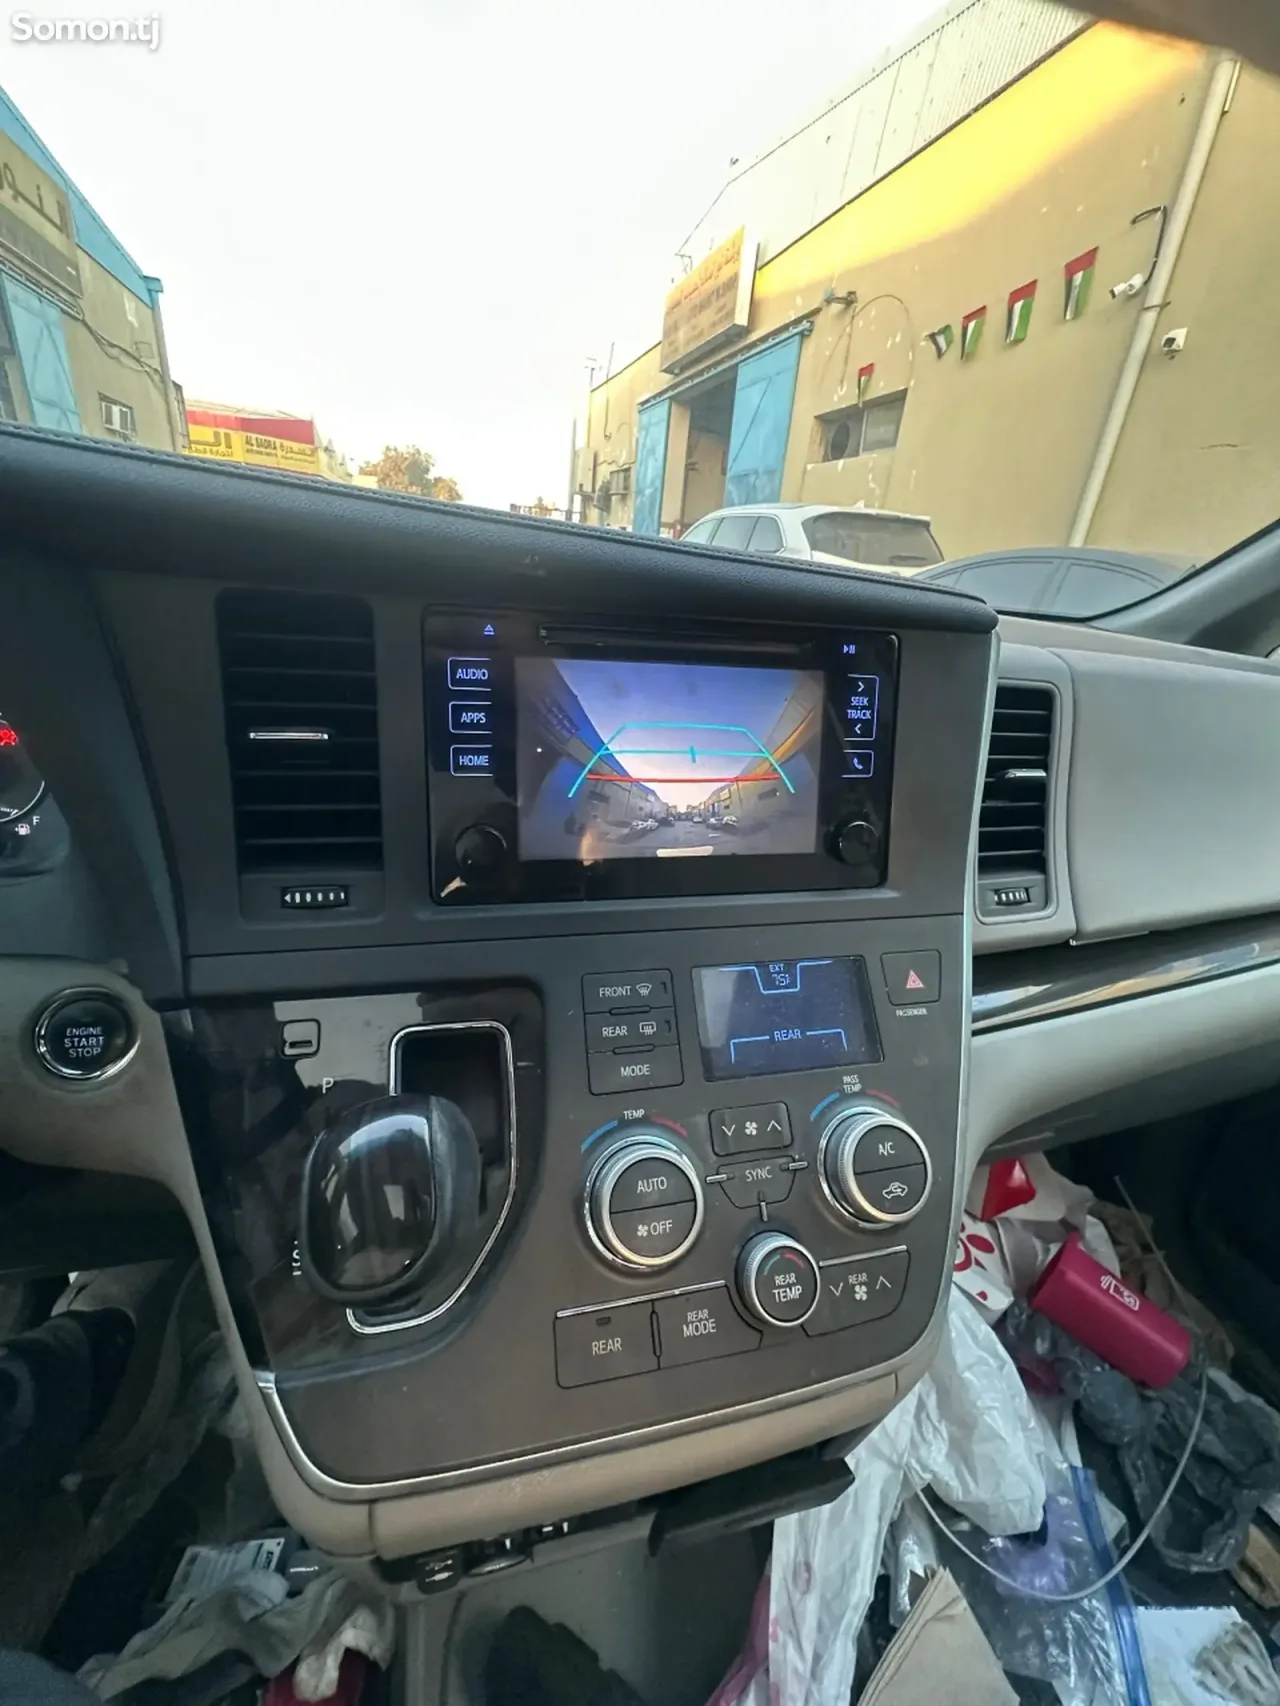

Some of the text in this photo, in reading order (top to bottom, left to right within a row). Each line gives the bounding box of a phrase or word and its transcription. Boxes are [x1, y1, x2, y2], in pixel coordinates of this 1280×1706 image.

[456, 668, 489, 680] AUDIO
[850, 696, 869, 706] SEEK
[460, 712, 486, 724] APPS
[846, 709, 872, 720] TRACK
[459, 755, 490, 766] HOME
[32, 815, 41, 826] F
[769, 963, 785, 973] EXT
[599, 985, 632, 998] FRONT
[895, 1007, 928, 1017] PASSENGER
[66, 1026, 103, 1037] ENGINE
[602, 1025, 628, 1038] REAR
[774, 1028, 802, 1042] REAR
[64, 1036, 105, 1048] START
[68, 1047, 102, 1059] STOP
[620, 1064, 651, 1078] MODE
[321, 1077, 334, 1094] P
[842, 1074, 860, 1084] PASS
[843, 1083, 863, 1094] TEMP
[623, 1108, 646, 1121] TEMP
[878, 1141, 896, 1156] A/C
[744, 1166, 773, 1182] SYNC
[636, 1176, 668, 1194] AUTO
[650, 1219, 673, 1236] OFF
[774, 1272, 797, 1286] REAR
[849, 1272, 869, 1285] REAR
[772, 1285, 803, 1304] TEMP
[686, 1308, 710, 1323] REAR
[682, 1319, 717, 1338] MODE
[591, 1336, 623, 1356] REAR
